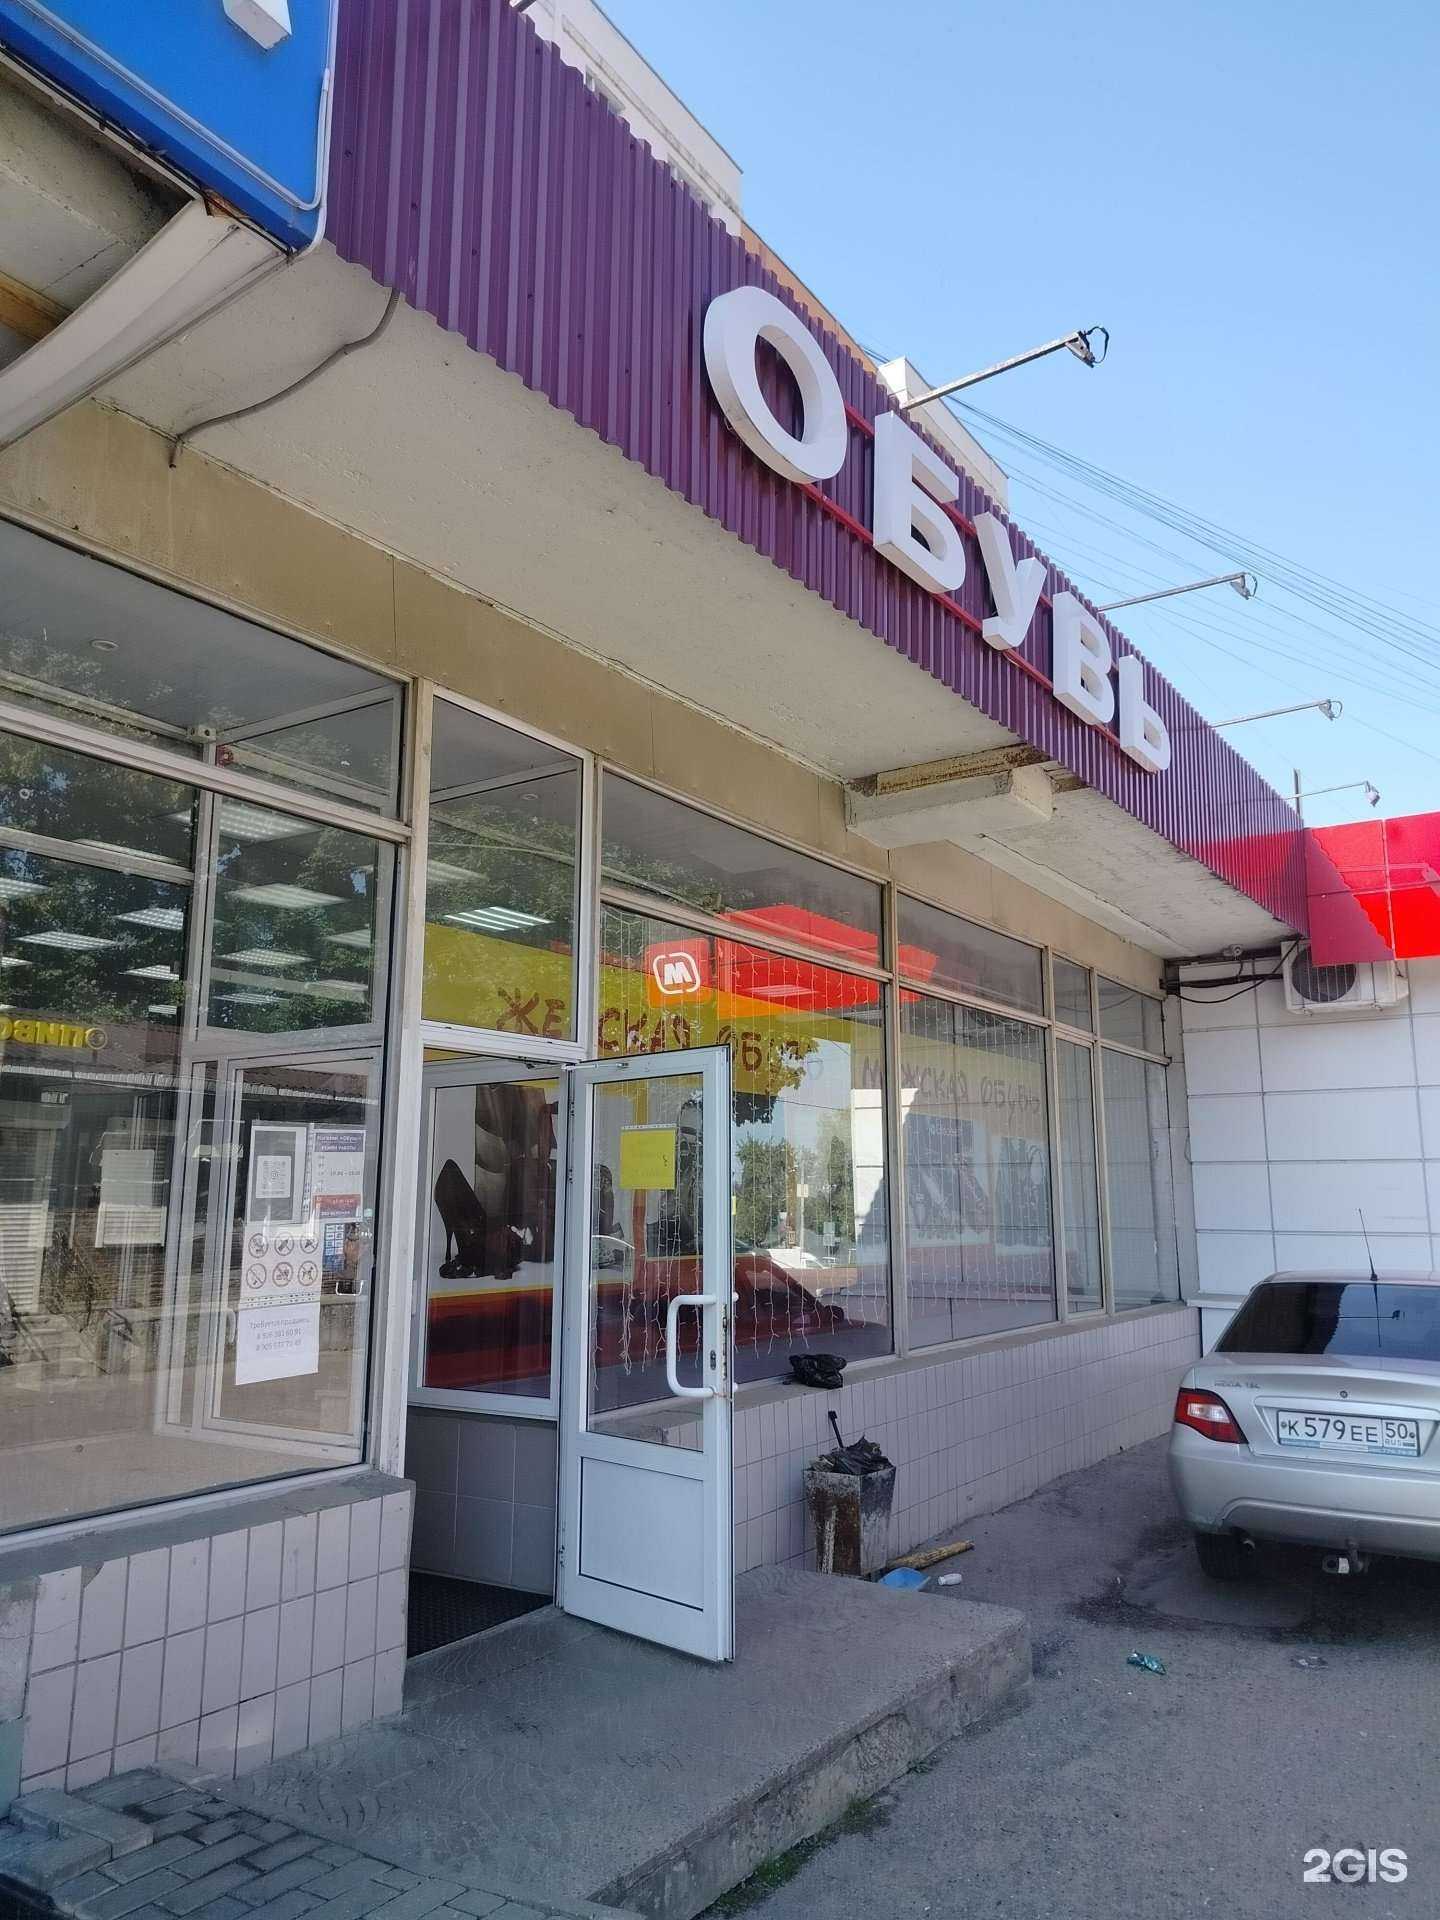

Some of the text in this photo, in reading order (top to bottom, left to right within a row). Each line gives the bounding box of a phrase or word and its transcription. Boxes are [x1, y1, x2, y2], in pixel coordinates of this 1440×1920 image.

[702, 284, 1172, 774] ОБУВЬ
[496, 987, 692, 1055] ЖЕСКАЯ
[862, 1055, 969, 1103] МЖСКАЯ
[1385, 1421, 1409, 1440] 50
